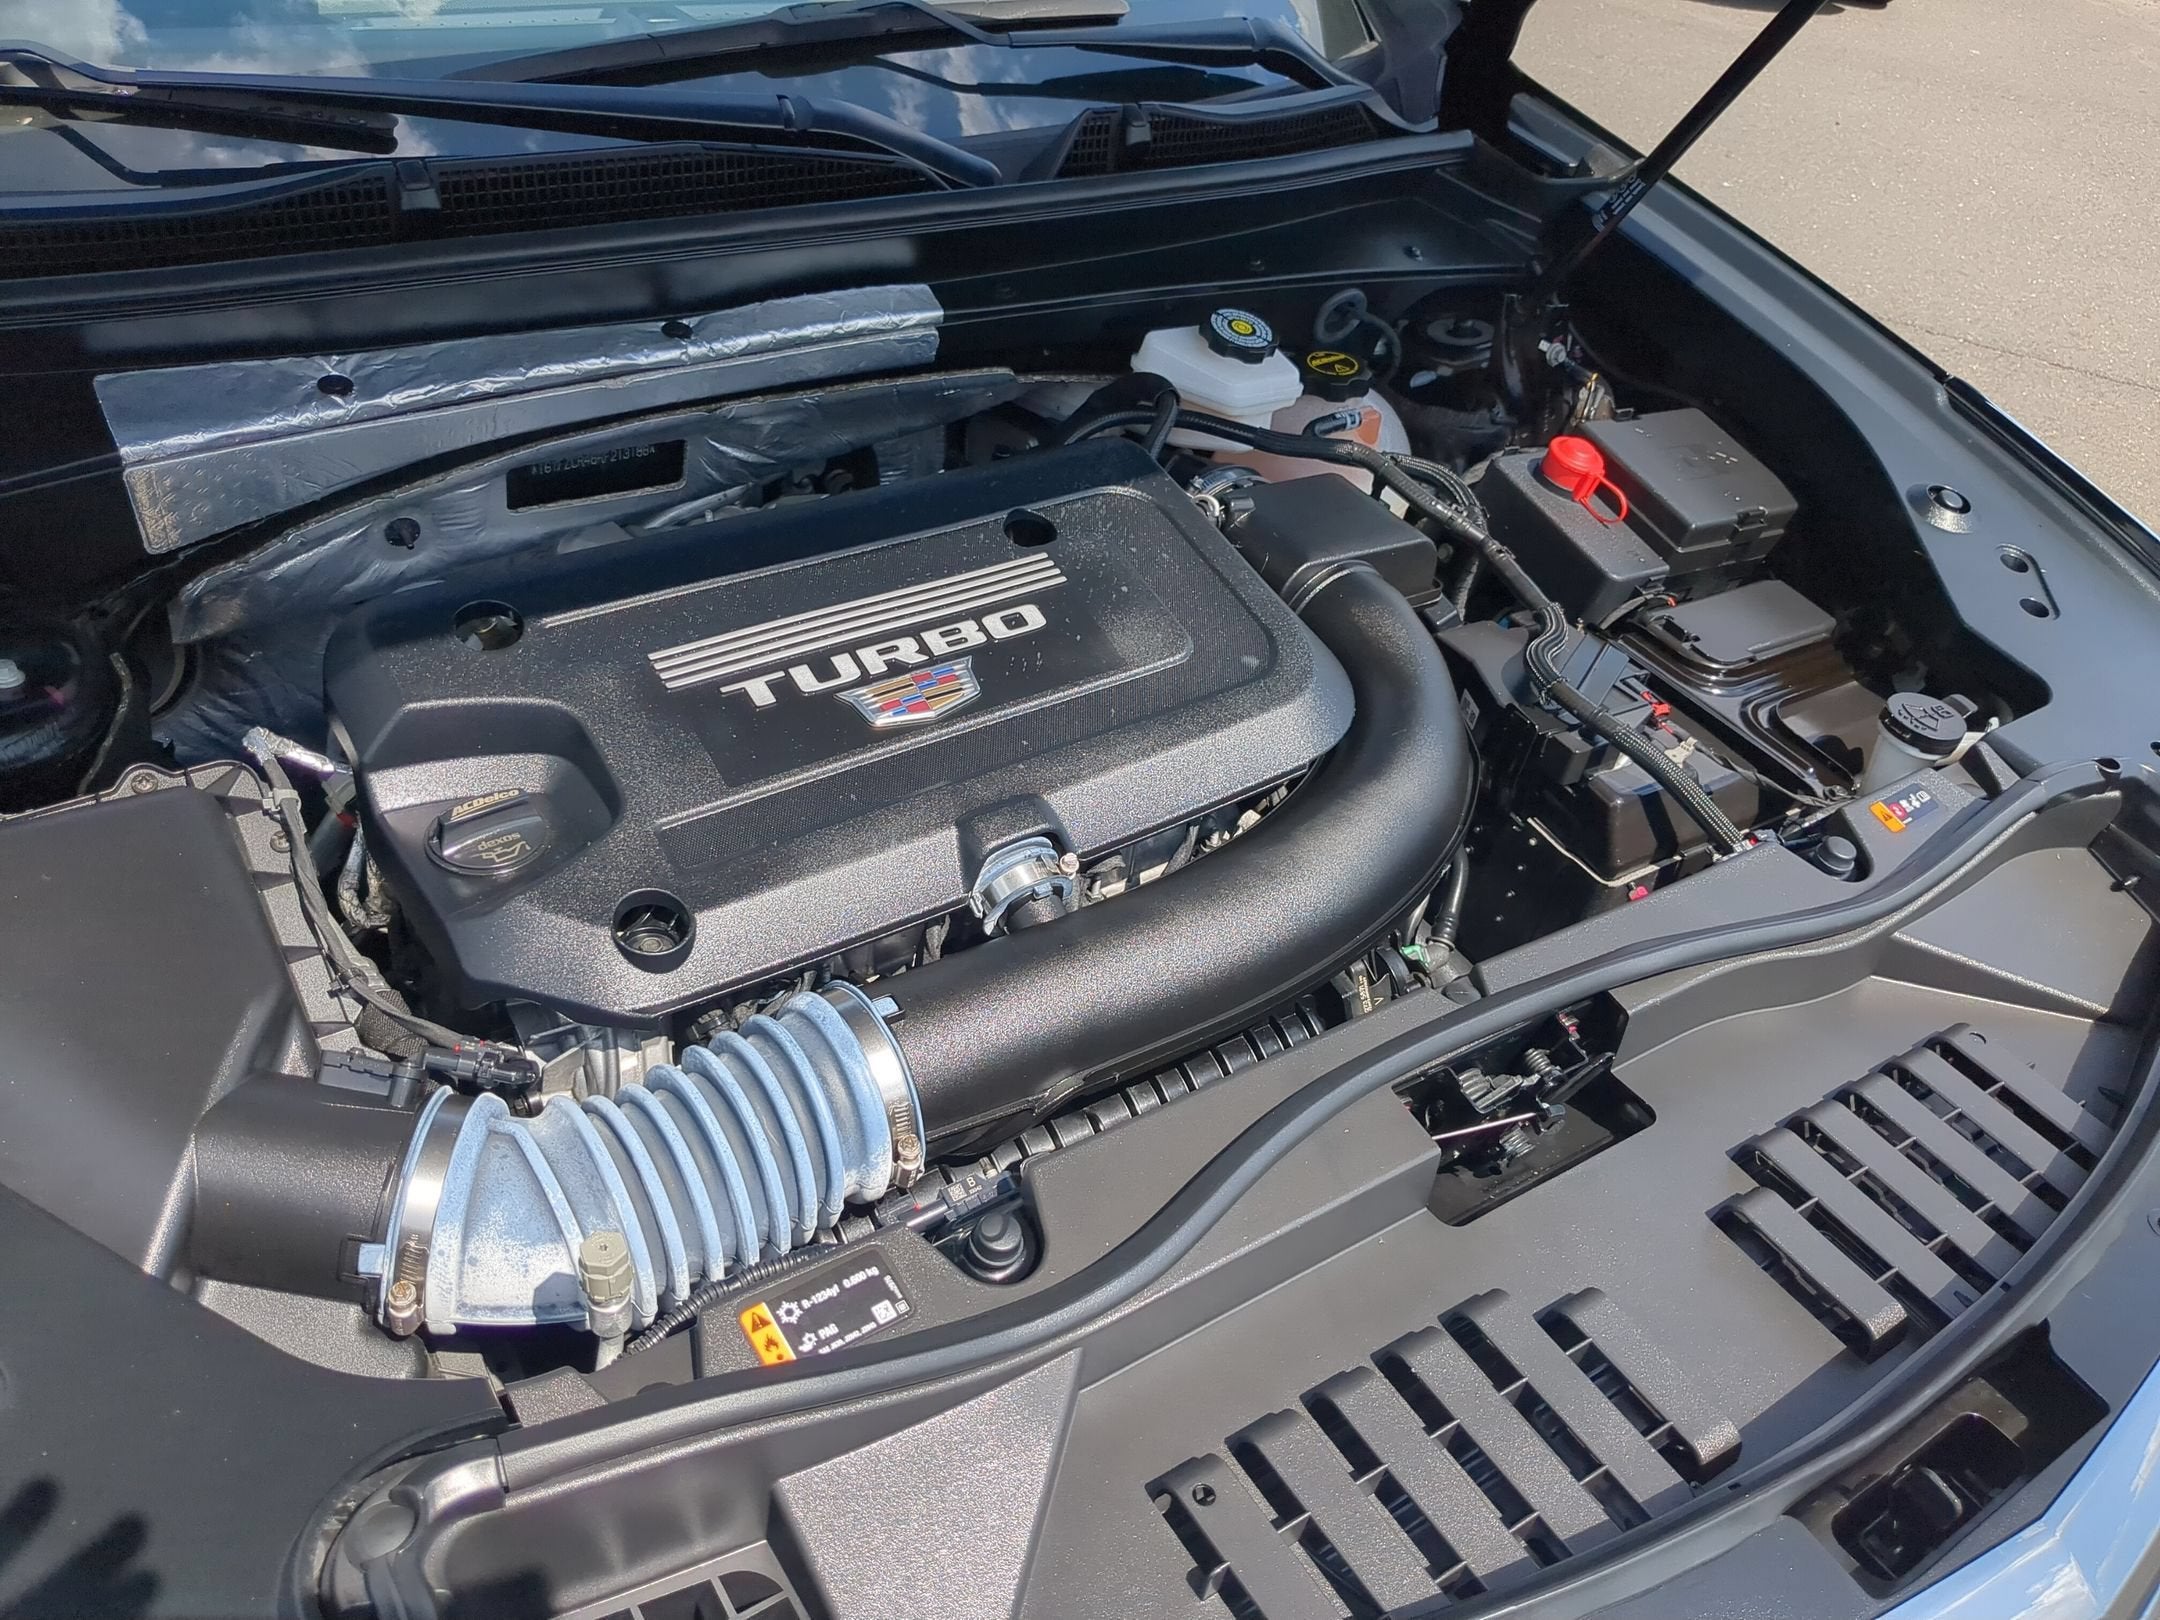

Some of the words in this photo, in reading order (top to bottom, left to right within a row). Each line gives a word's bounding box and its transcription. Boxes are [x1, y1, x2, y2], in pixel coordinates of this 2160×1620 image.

[719, 603, 1047, 710] TURBO
[452, 789, 519, 817] ACDelco
[478, 832, 521, 850] dexos
[967, 1177, 976, 1187] B
[865, 1266, 880, 1277] kg
[818, 1323, 839, 1340] PAG
